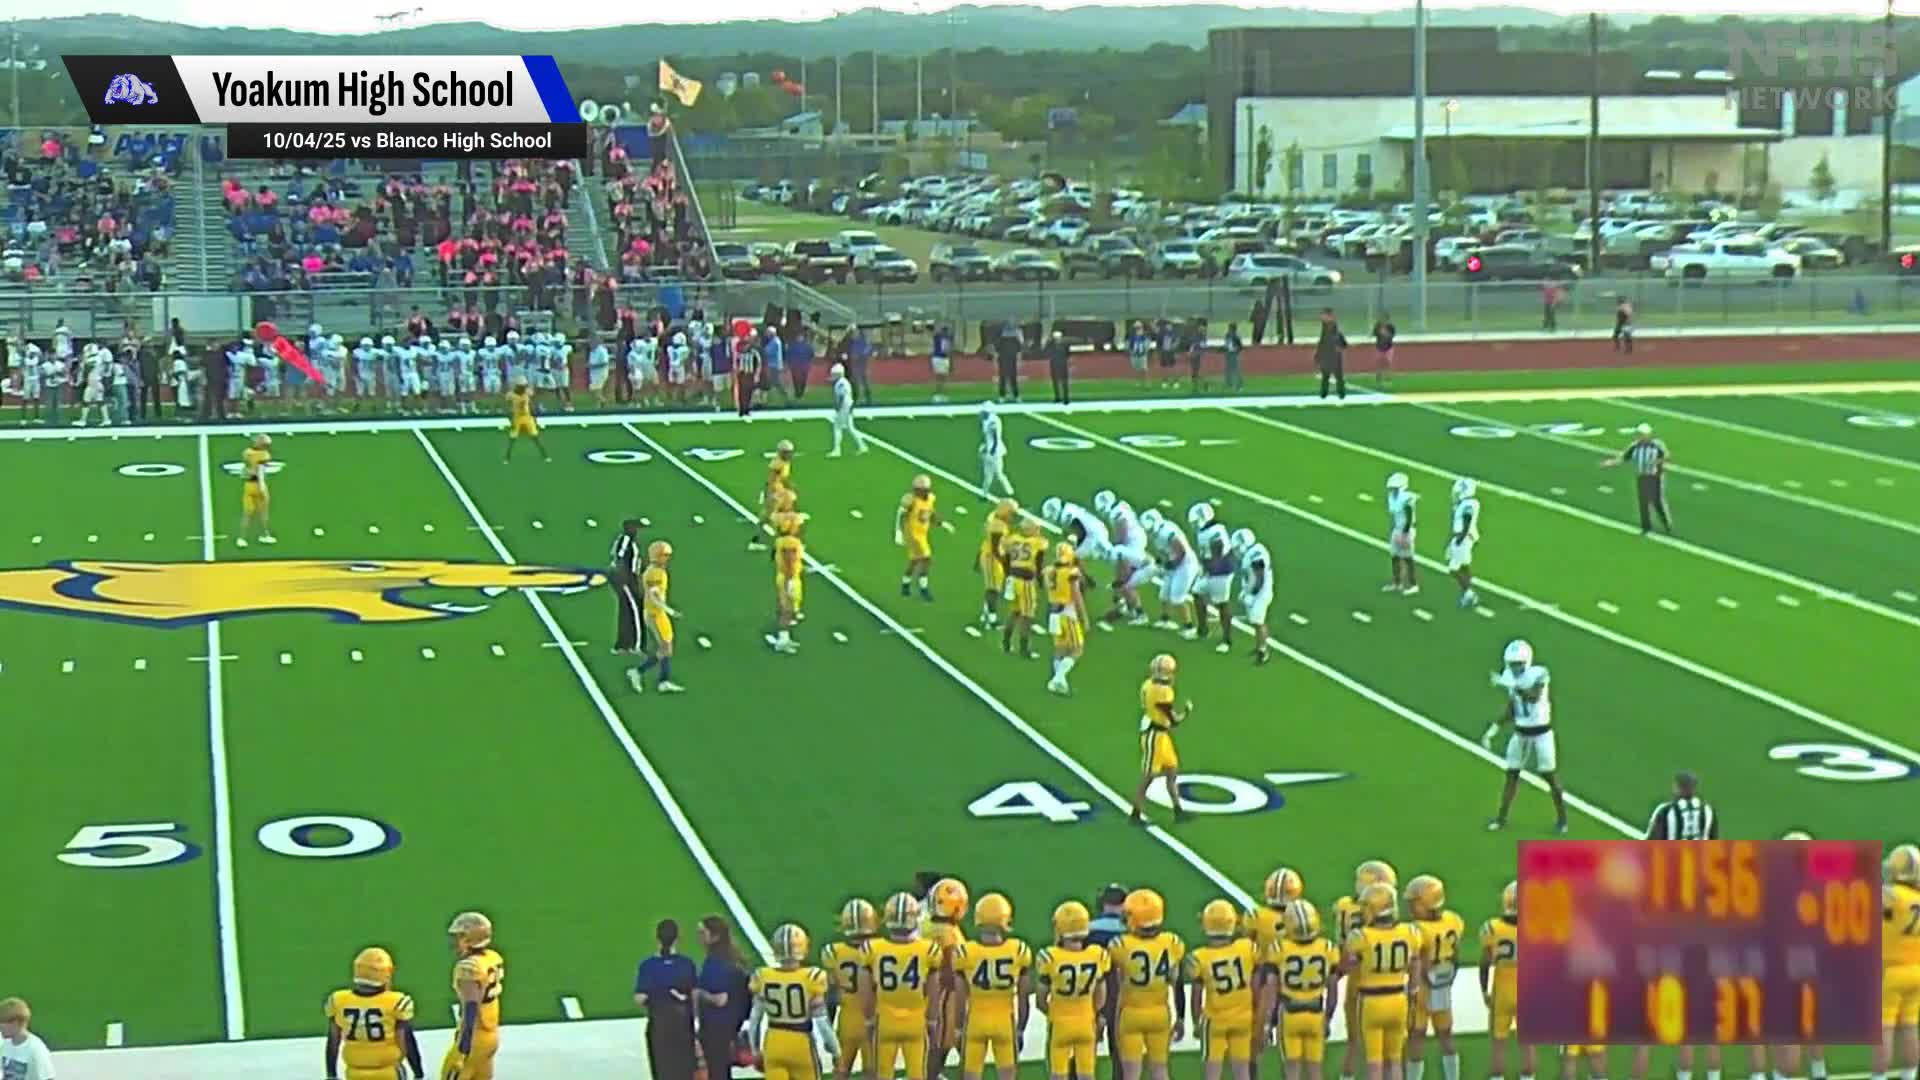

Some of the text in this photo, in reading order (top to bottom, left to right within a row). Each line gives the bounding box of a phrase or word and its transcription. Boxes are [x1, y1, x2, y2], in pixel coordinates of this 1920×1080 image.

[879, 955, 920, 990] 64
[1130, 951, 1169, 985] 34
[1285, 955, 1326, 989] 23
[1374, 940, 1408, 973] 10
[839, 961, 858, 993] 3
[972, 959, 1014, 990] 45
[1057, 964, 1097, 996] 37
[1212, 957, 1245, 993] 51
[764, 983, 806, 1018] 50
[343, 1008, 385, 1041] 76
